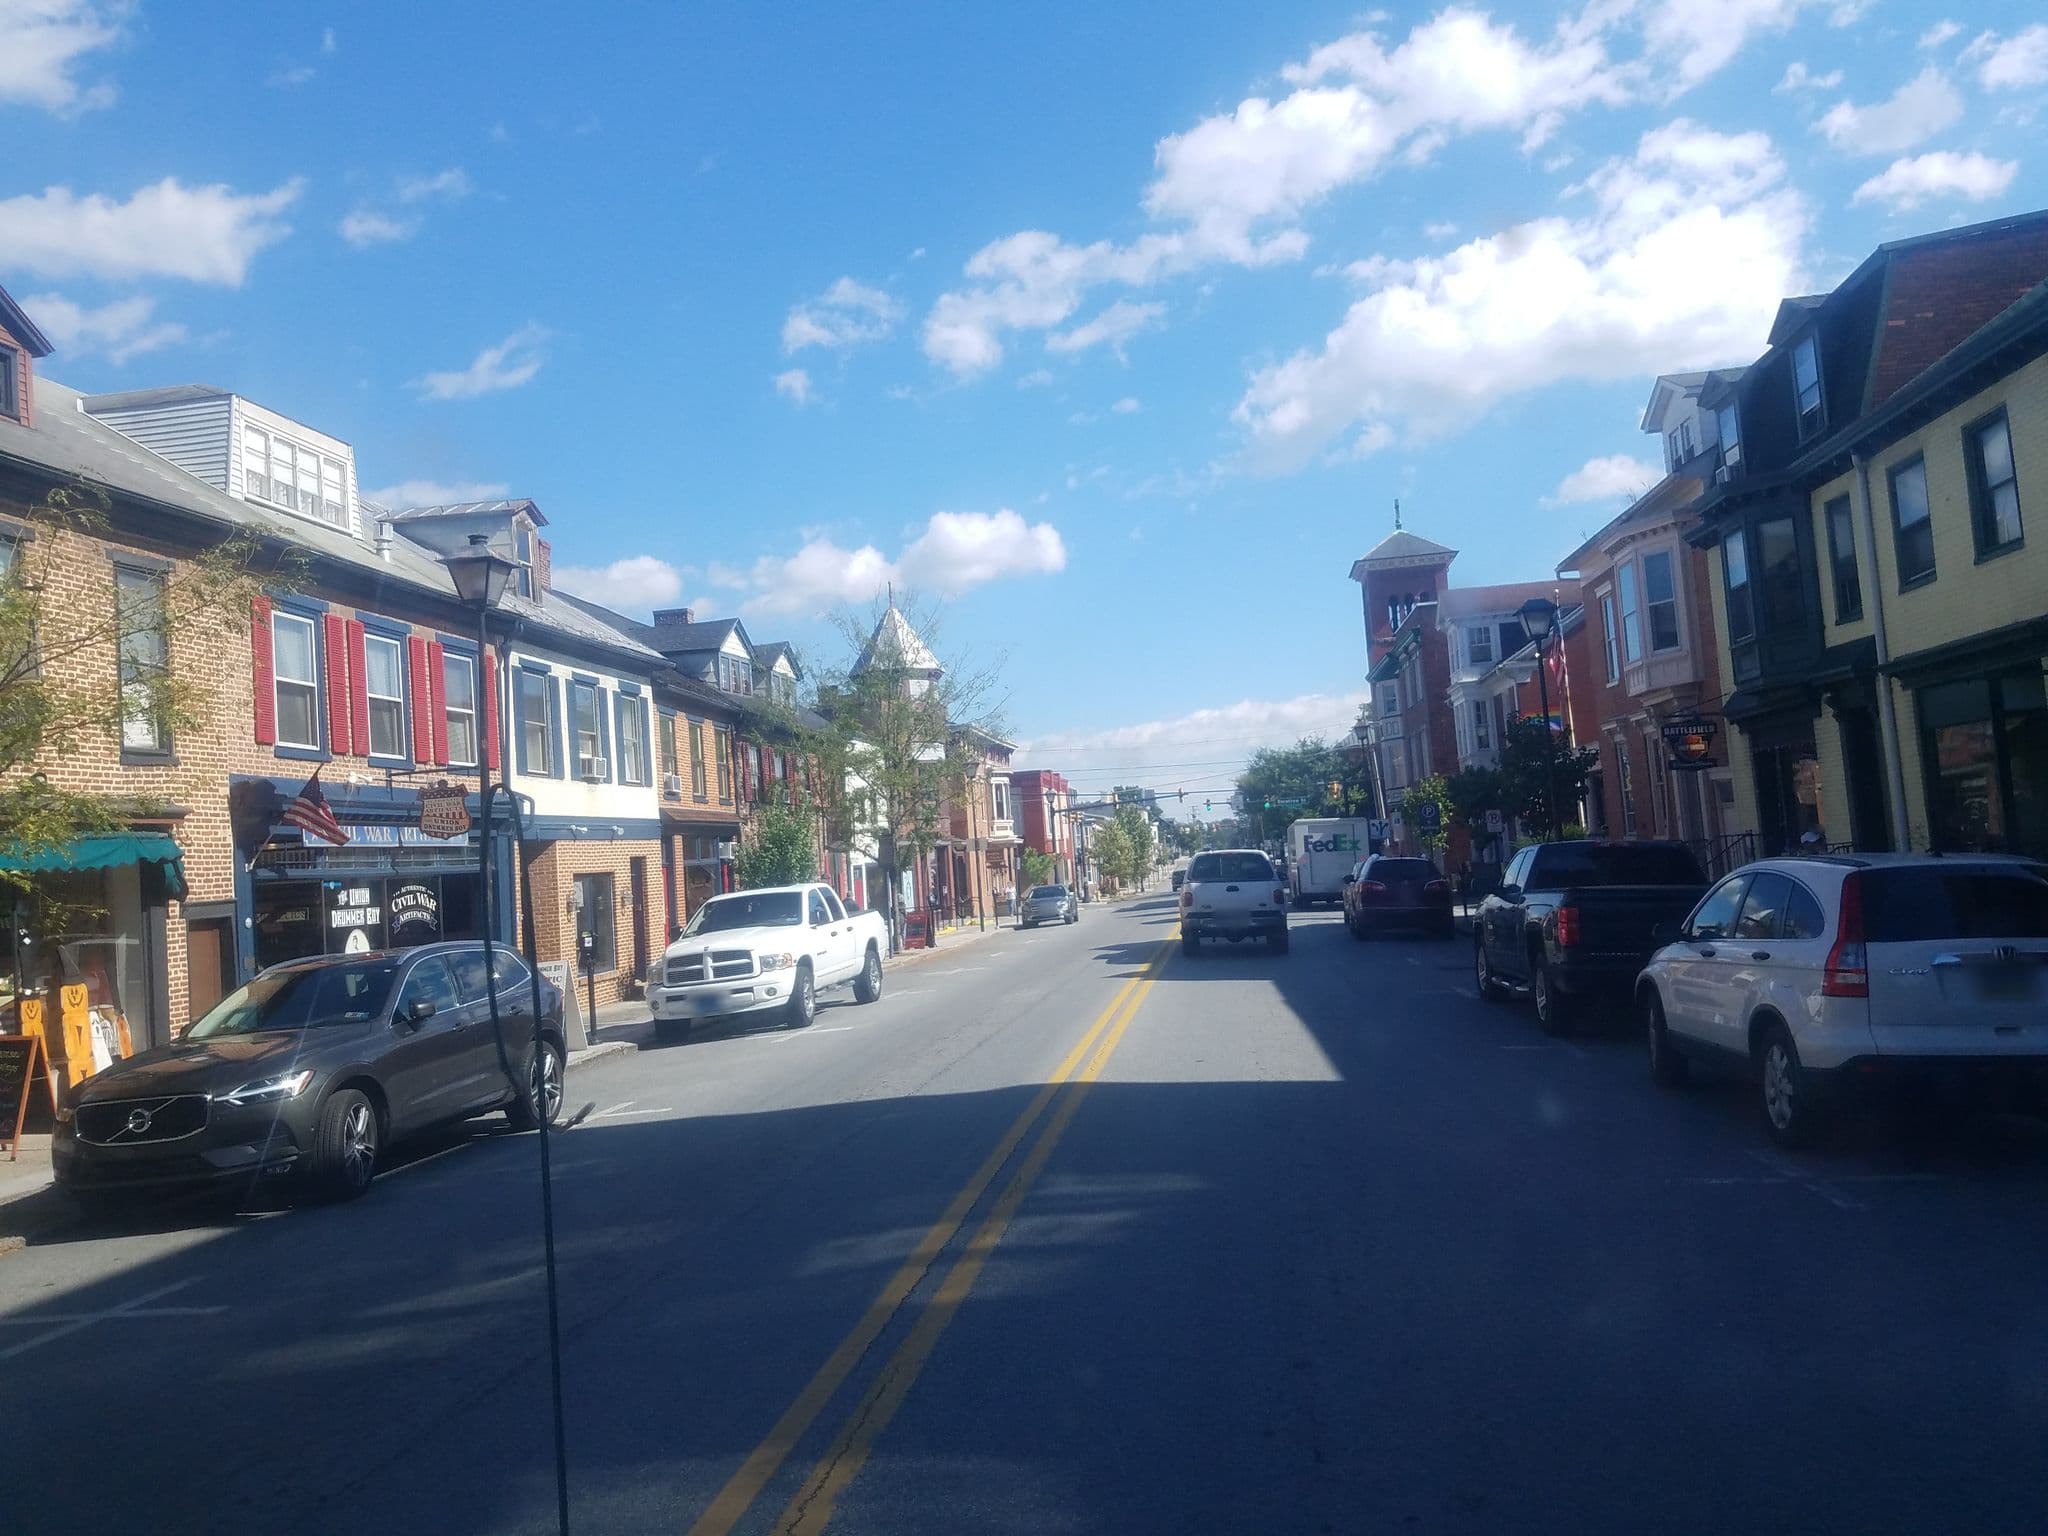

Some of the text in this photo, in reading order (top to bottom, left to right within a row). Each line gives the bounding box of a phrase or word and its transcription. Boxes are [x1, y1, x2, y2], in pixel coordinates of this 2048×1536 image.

[1664, 725, 1715, 735] BATTLEFIELD
[364, 826, 392, 841] WAR
[1304, 834, 1361, 852] FedEx
[350, 888, 369, 906] UNION
[392, 892, 437, 912] CIVIL WAR
[331, 909, 364, 929] DRUMMER
[367, 907, 380, 925] BOY
